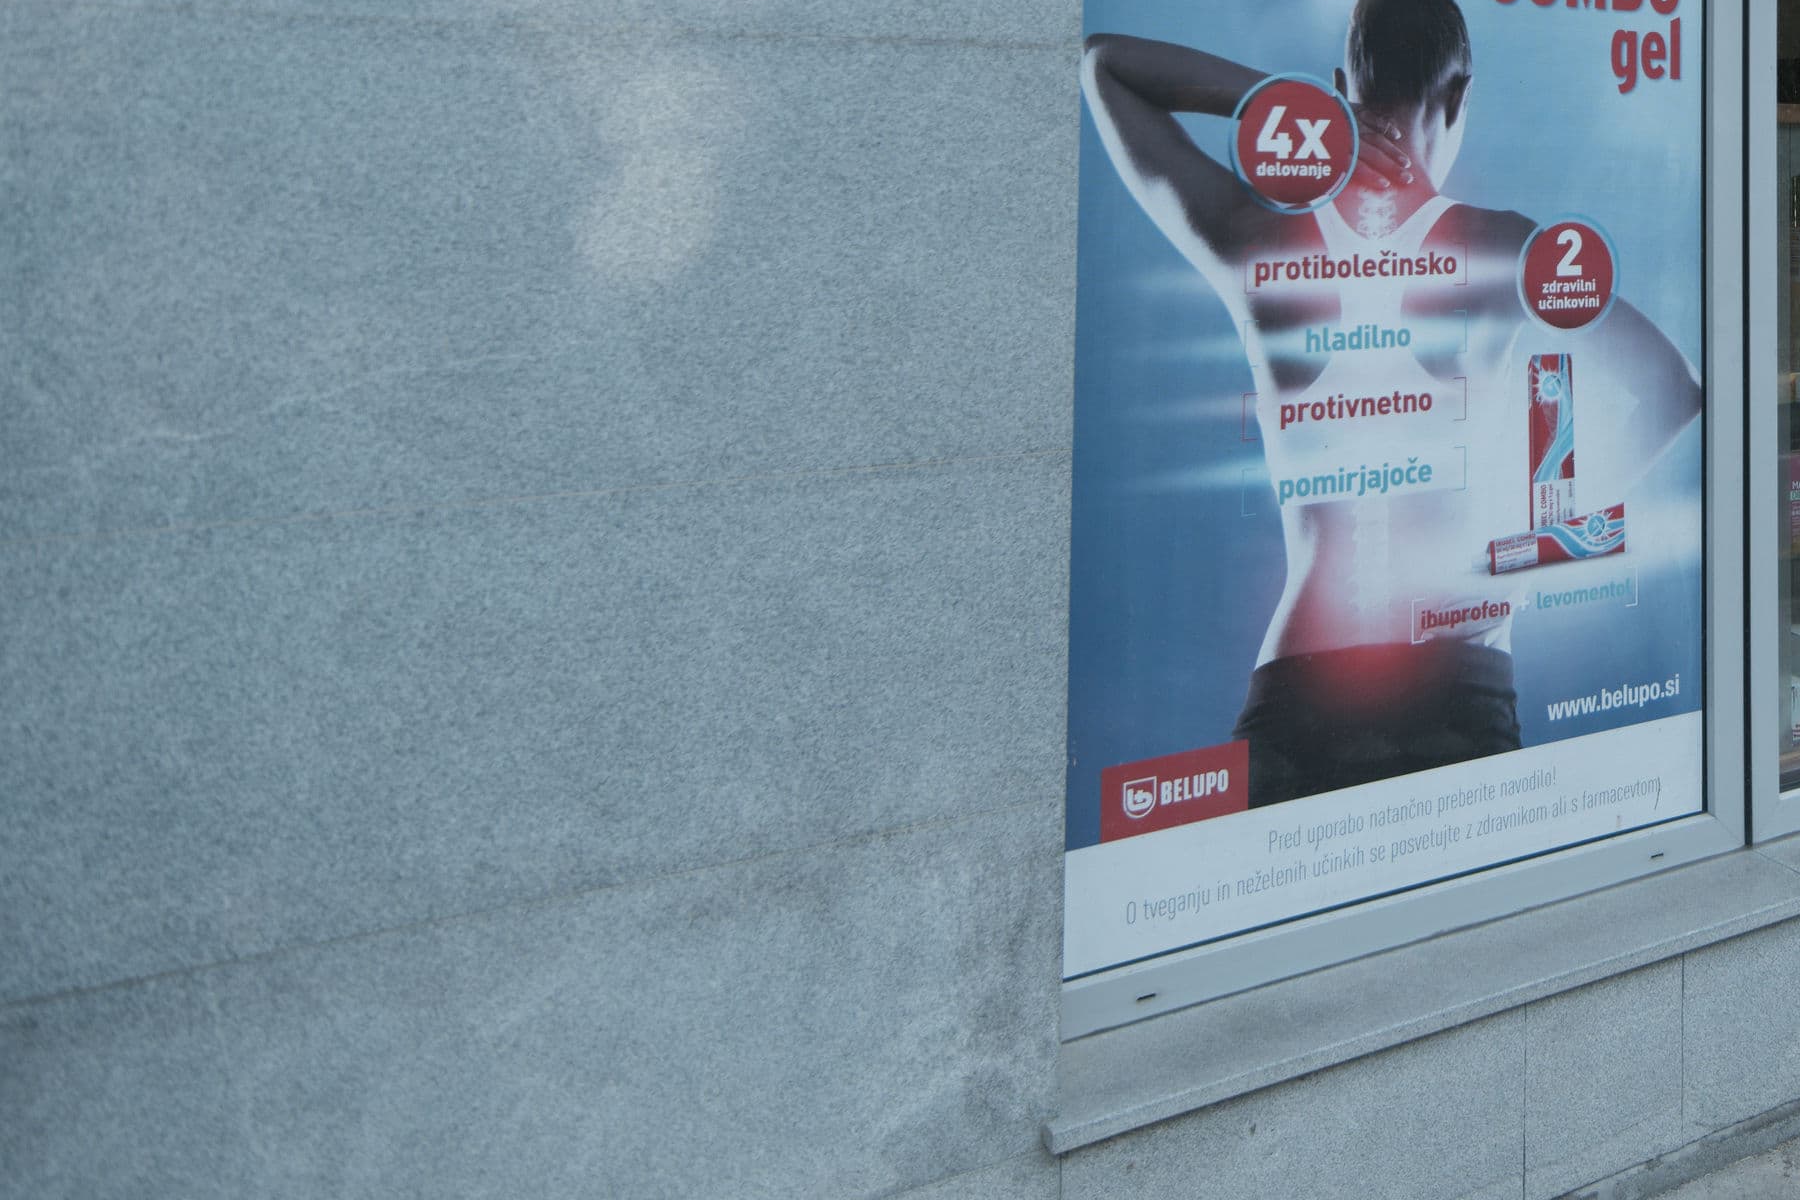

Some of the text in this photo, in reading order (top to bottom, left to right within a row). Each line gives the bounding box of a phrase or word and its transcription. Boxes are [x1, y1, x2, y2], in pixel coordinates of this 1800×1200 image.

[1611, 16, 1681, 94] gel
[1256, 104, 1332, 160] 4x
[1256, 161, 1332, 180] delovanje
[1254, 250, 1458, 287] protibolečinsko
[1556, 228, 1583, 277] 2
[1538, 294, 1600, 310] učinkovini
[1541, 278, 1597, 294] zdravilni
[1305, 324, 1412, 354] hladilno
[1279, 391, 1434, 430] protivnetno
[1278, 457, 1434, 505] pomirjajoče
[1536, 577, 1631, 610] levomentol
[1420, 599, 1512, 630] ibuprofen
[1547, 673, 1681, 721] www.belupo.si
[1160, 768, 1229, 806] BELUPO
[1268, 765, 1557, 853] Pred uporabo natančno preberite navodilo!
[1125, 900, 1138, 925] O
[1143, 889, 1211, 921] tveganju
[1216, 879, 1231, 903] in
[1236, 860, 1307, 898] neželenih
[1312, 842, 1365, 878] učinkih
[1369, 846, 1386, 864] se
[1391, 823, 1461, 863] posvetujte
[1464, 827, 1473, 840] z
[1476, 805, 1548, 837] zdravnikom
[1551, 795, 1568, 817] ali
[1571, 800, 1579, 813] s
